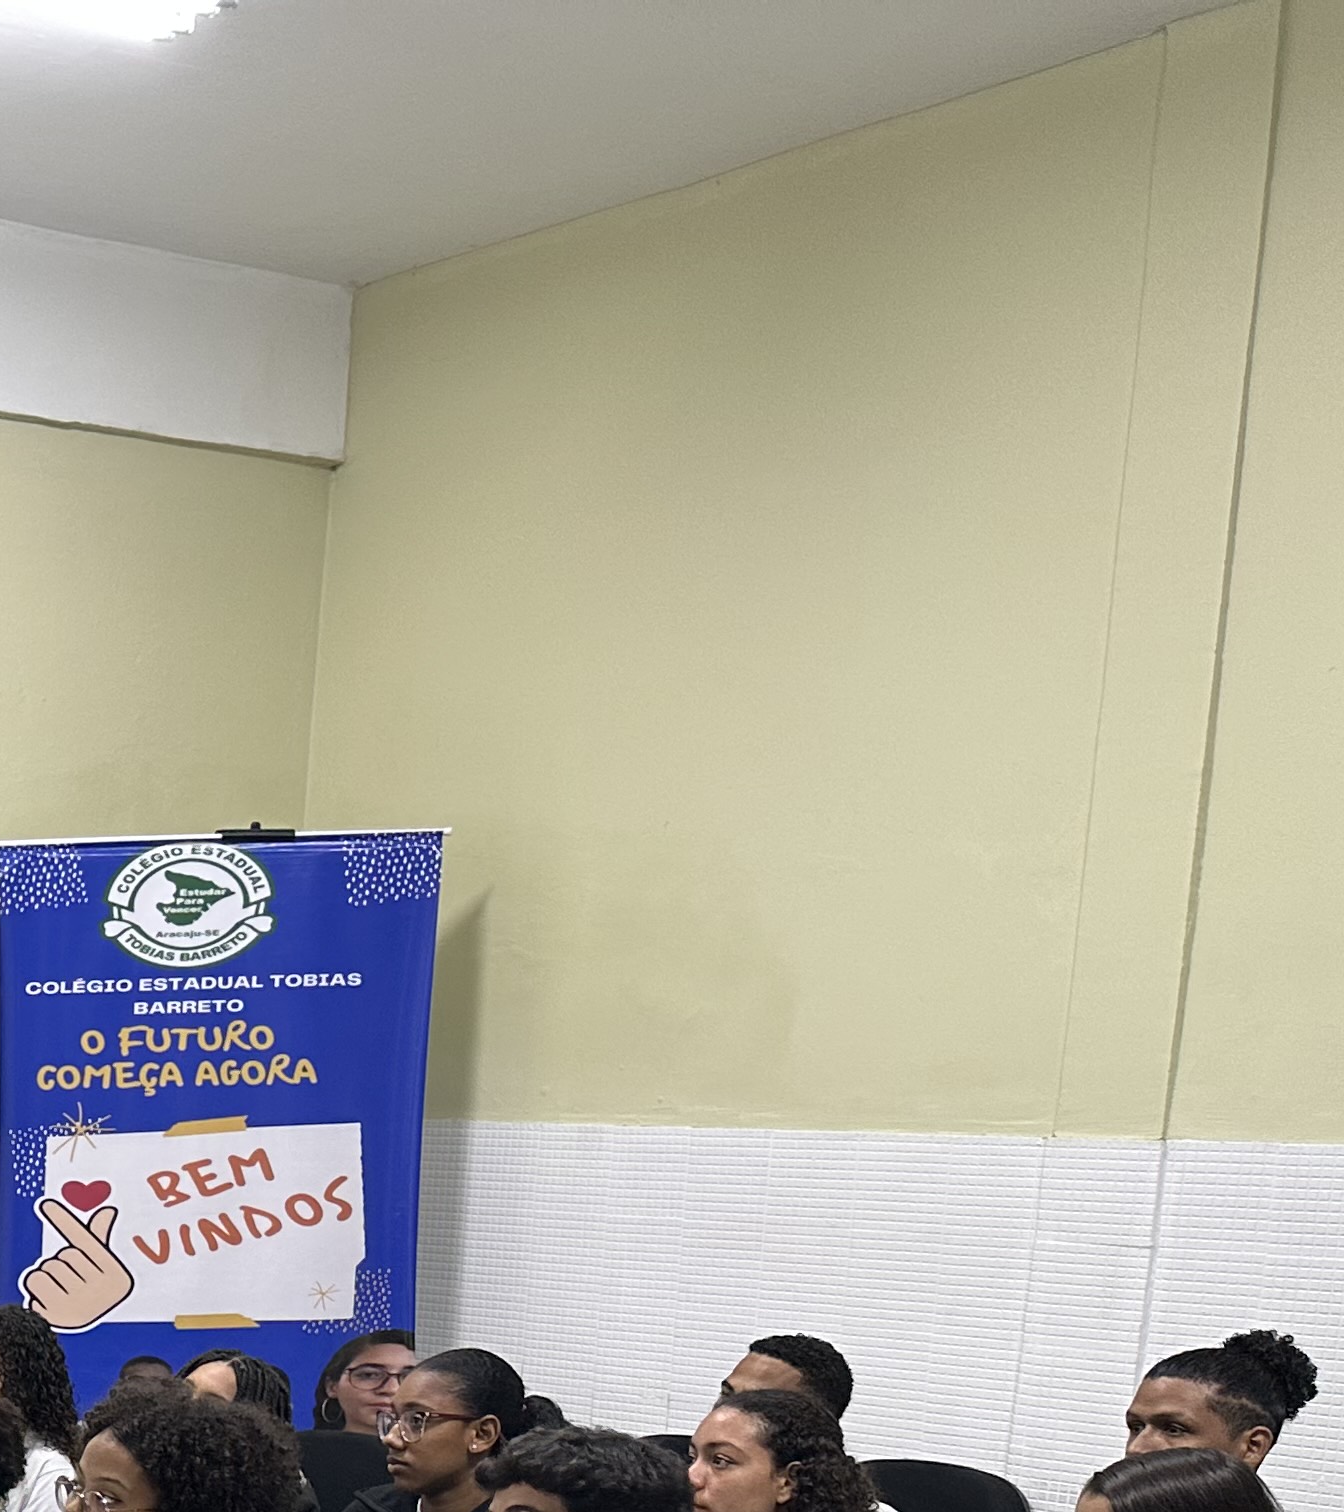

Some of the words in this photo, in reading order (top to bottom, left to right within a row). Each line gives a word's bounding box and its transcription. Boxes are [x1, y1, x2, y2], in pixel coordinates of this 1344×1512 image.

[117, 847, 183, 893] COLÉGIO
[191, 844, 266, 894] ESTADUAL
[176, 897, 204, 905] Para
[179, 888, 226, 897] Estudar
[163, 906, 203, 914] Vencer
[124, 933, 175, 961] TOBIAS
[179, 931, 248, 961] BARRETO
[156, 929, 220, 939] Aracaju-SE
[25, 977, 133, 996] COLÉGIO
[138, 975, 264, 993] ESTADUAL
[270, 972, 363, 989] TOBIAS
[133, 999, 244, 1015] BARRETO
[80, 1030, 105, 1056] O
[118, 1020, 275, 1057] FUTURO
[36, 1061, 184, 1097] COMEÇA
[195, 1054, 318, 1087] AGORA
[146, 1148, 275, 1208] BEM
[132, 1175, 353, 1265] VINDOS
